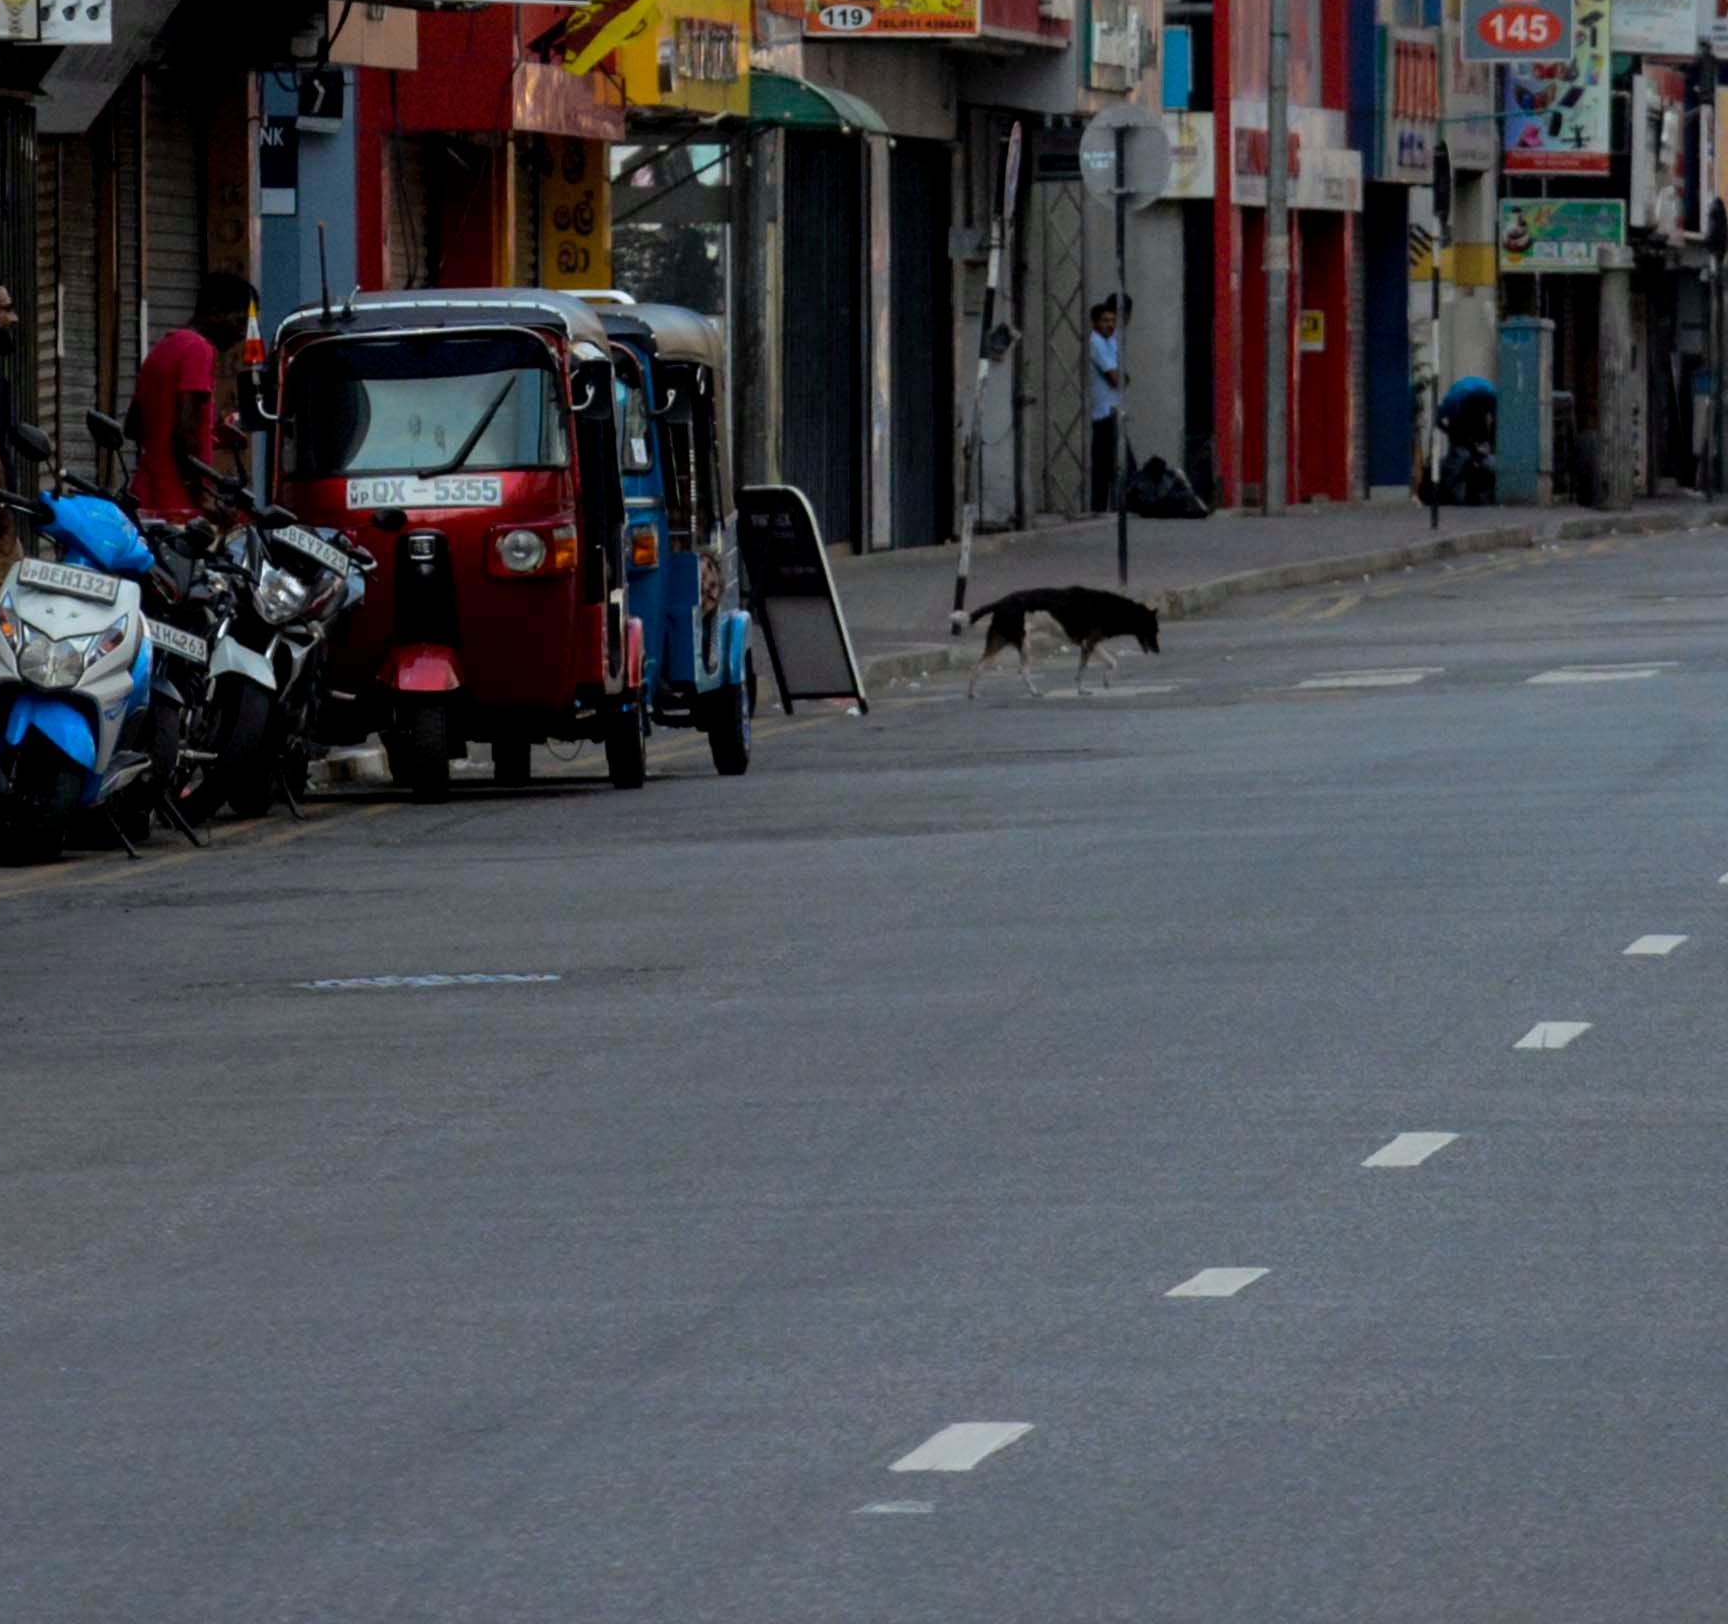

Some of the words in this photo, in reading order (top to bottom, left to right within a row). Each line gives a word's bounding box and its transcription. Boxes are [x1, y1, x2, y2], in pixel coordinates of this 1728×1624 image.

[824, 8, 864, 26] 119
[1488, 14, 1551, 42] 145
[373, 479, 404, 504] QX
[433, 478, 499, 504] 5355
